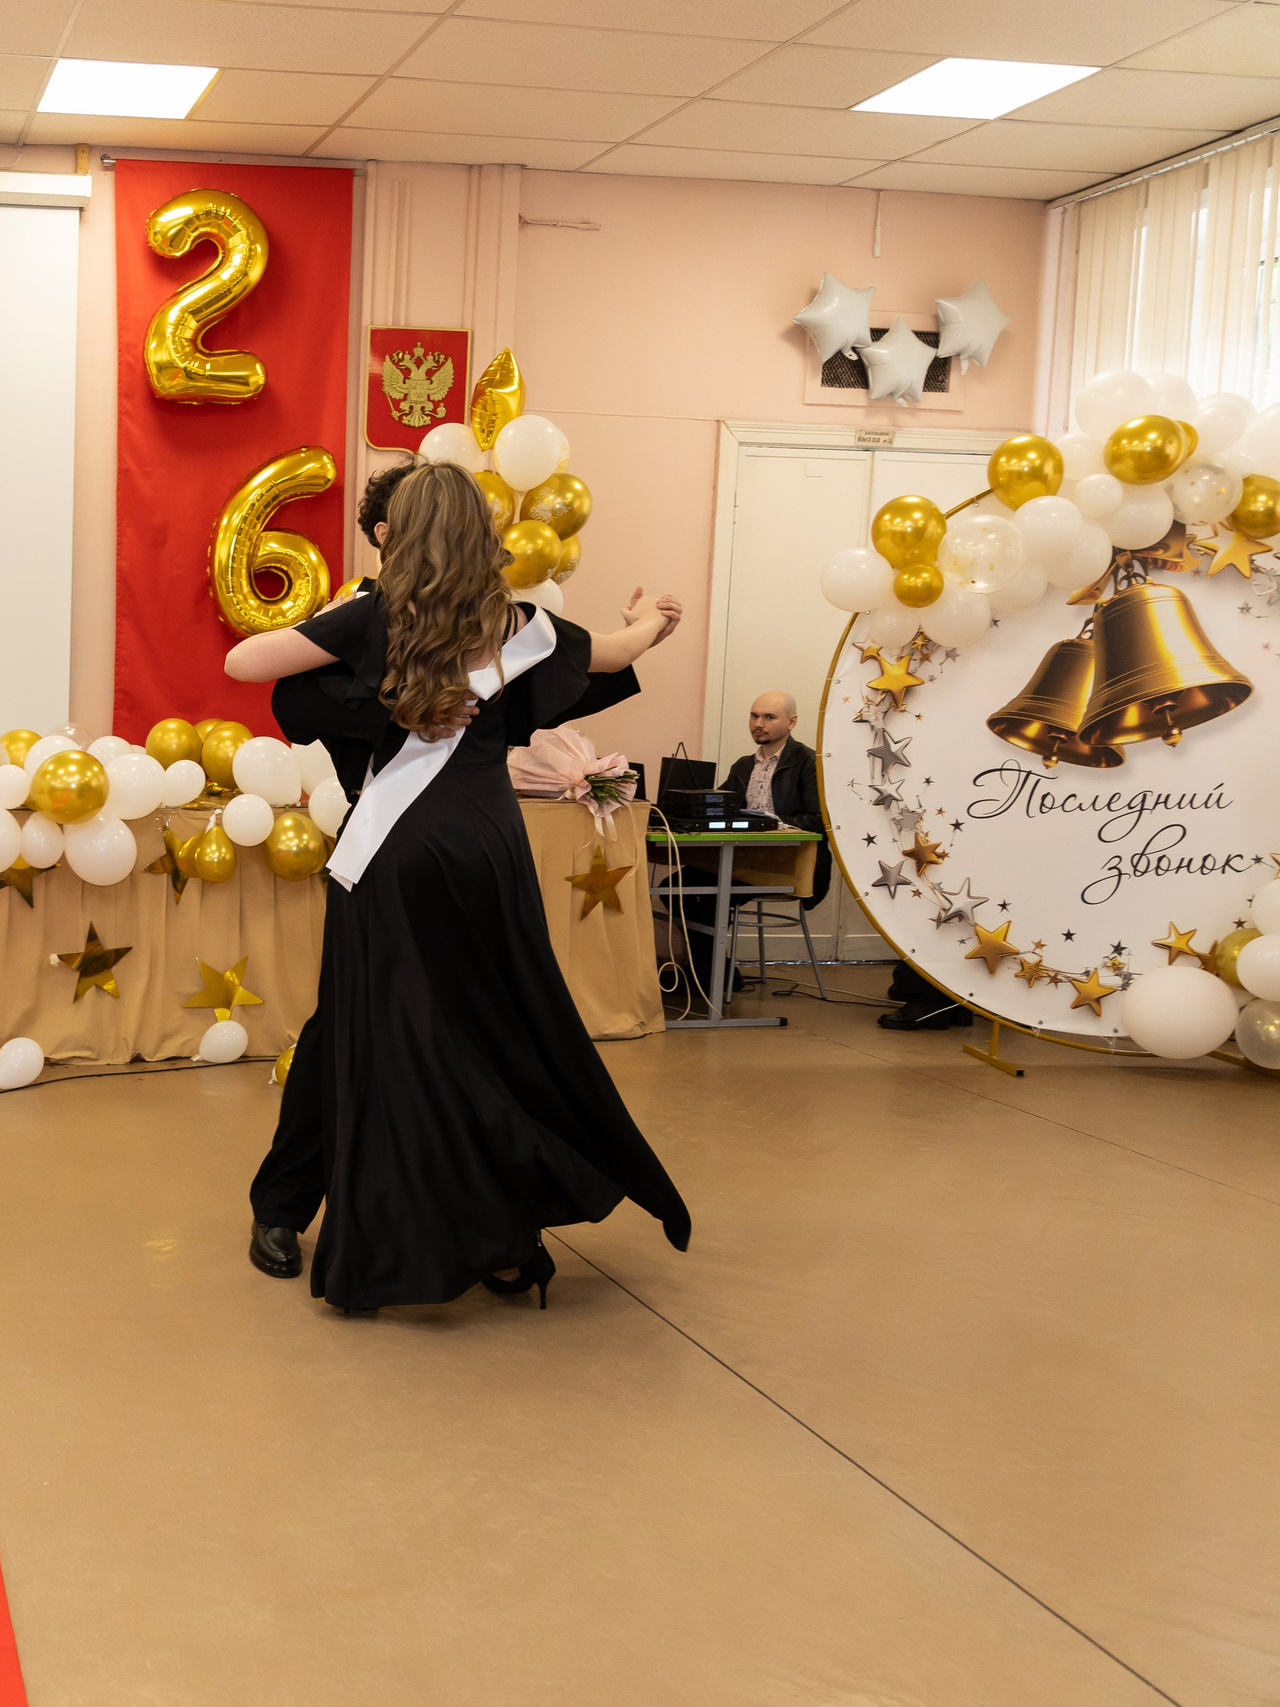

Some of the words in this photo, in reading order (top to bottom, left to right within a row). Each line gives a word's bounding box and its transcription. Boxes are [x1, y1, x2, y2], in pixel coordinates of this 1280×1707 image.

[144, 188, 269, 405] 2
[207, 445, 337, 638] 6
[966, 758, 1234, 844] Последний
[1080, 823, 1252, 905] звонок
